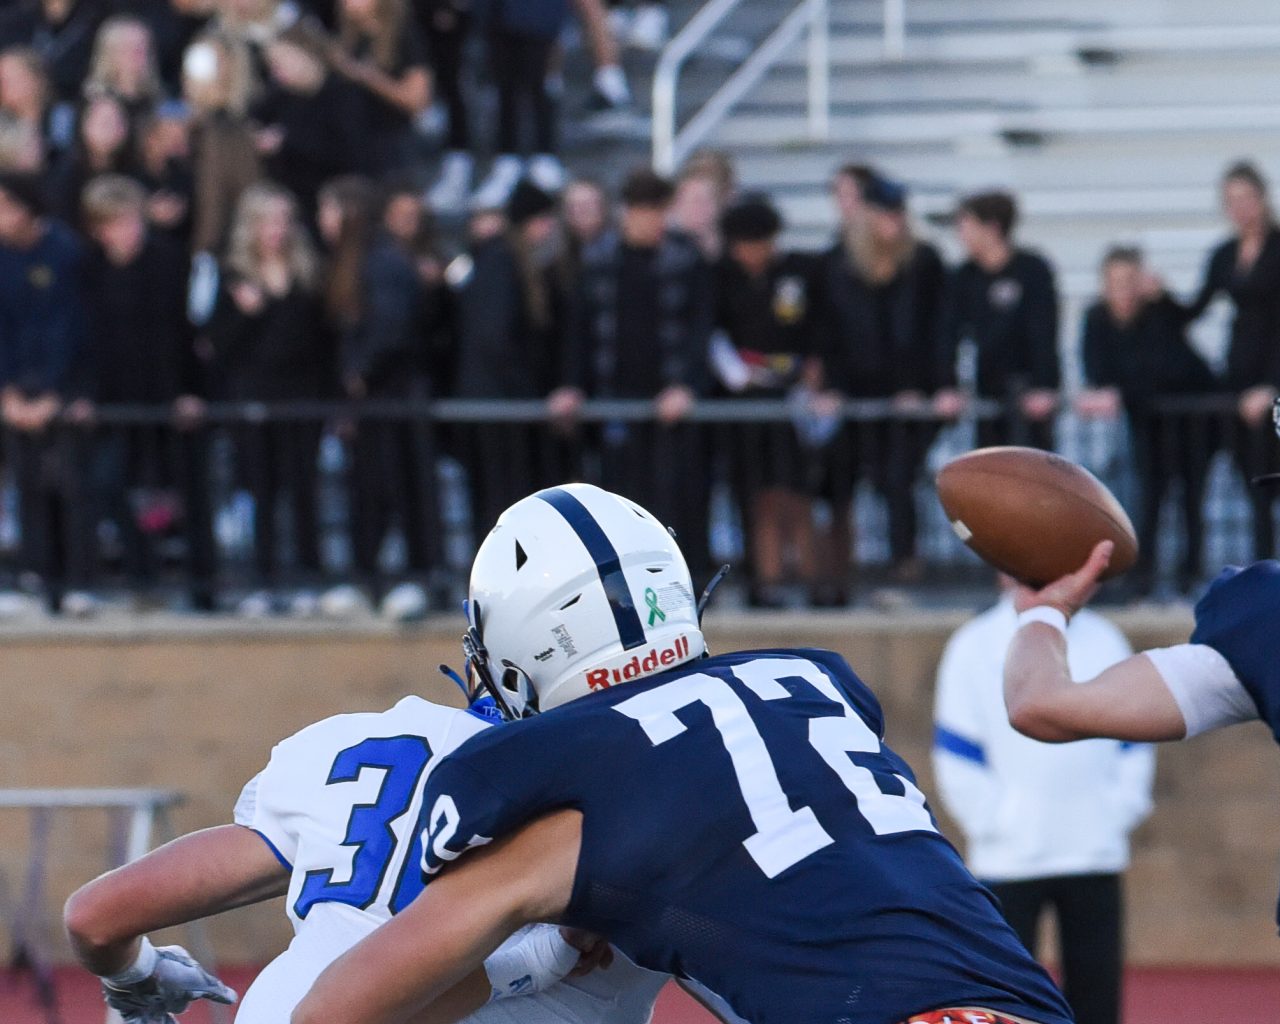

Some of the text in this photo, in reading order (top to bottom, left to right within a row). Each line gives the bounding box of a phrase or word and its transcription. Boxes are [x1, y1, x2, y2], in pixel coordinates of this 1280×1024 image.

[586, 636, 689, 692] Riddell
[293, 734, 433, 917] 3
[610, 658, 943, 880] 72
